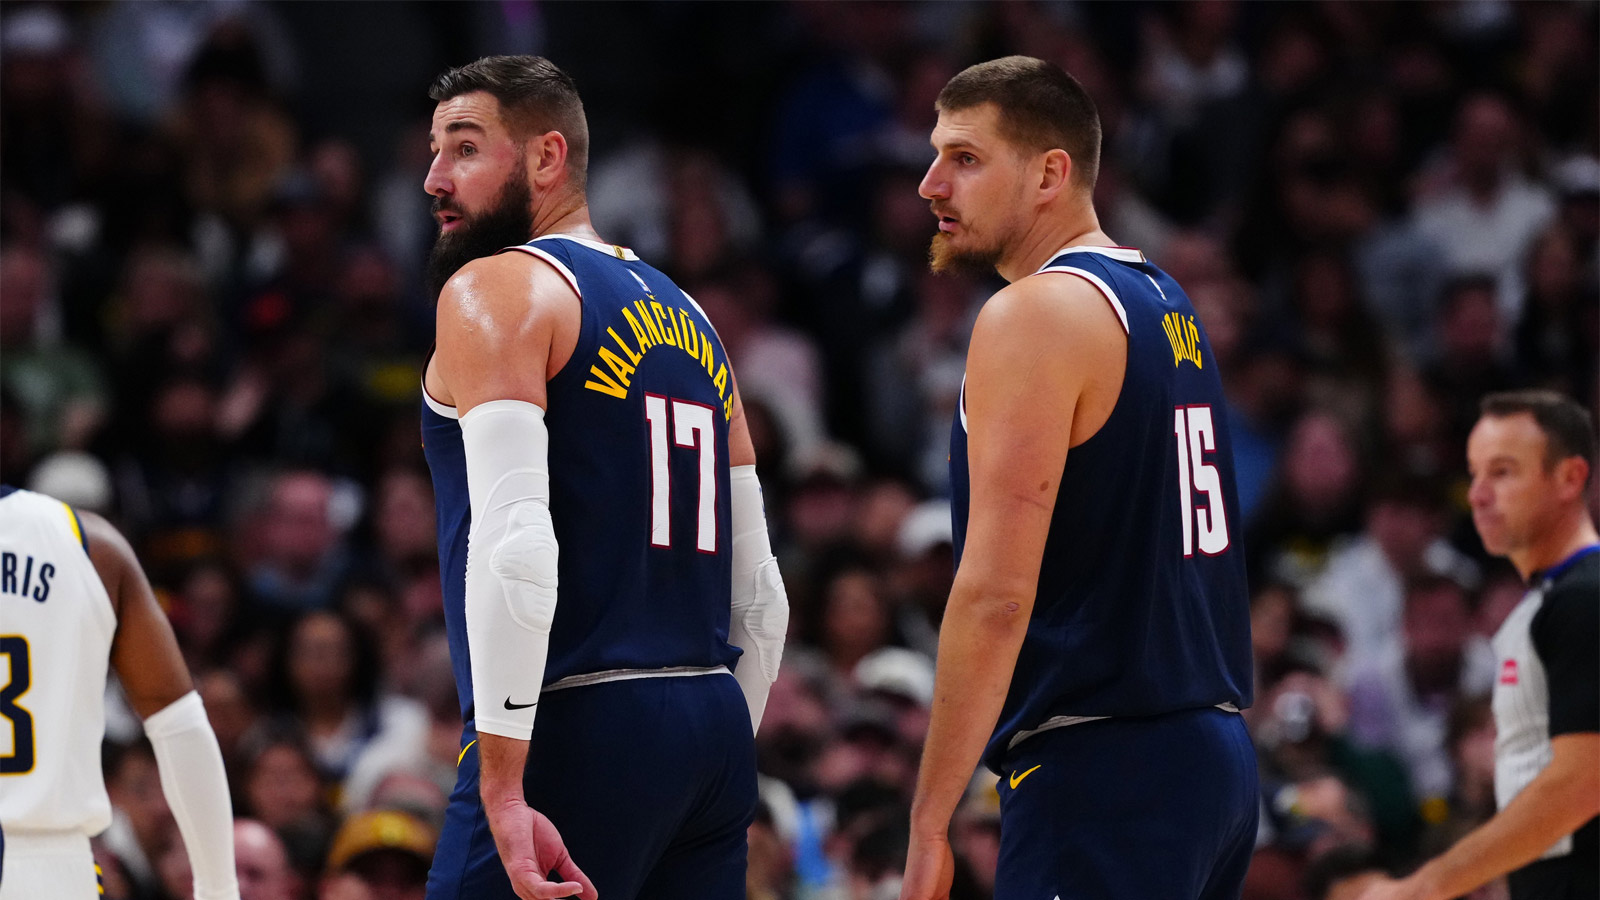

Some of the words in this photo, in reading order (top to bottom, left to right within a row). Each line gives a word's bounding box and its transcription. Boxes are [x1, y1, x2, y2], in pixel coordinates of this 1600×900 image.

[584, 293, 733, 424] VALANČIŪNAS
[1161, 311, 1203, 369] JOKIĆ
[644, 391, 717, 555] 17
[1174, 403, 1230, 559] 15
